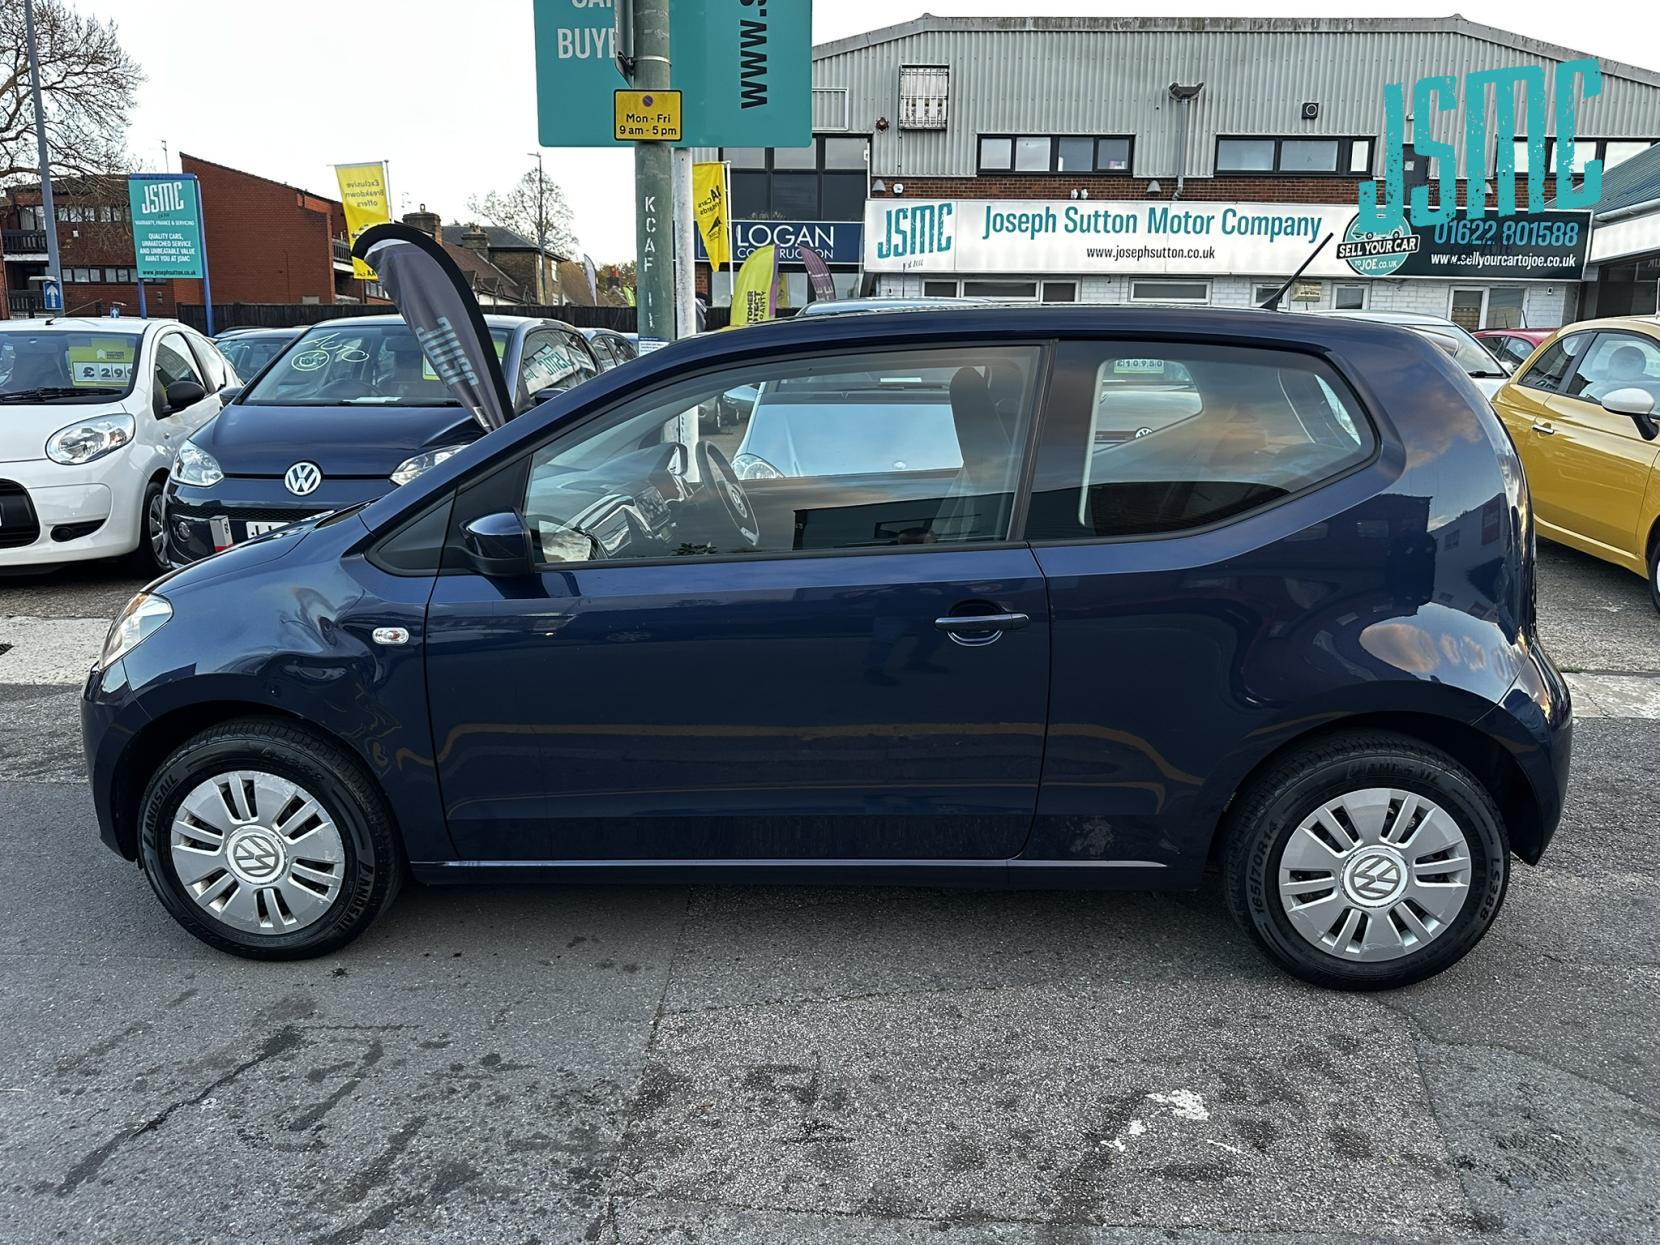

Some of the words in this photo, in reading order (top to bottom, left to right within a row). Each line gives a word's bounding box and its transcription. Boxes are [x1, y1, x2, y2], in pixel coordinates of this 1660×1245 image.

[557, 28, 615, 59] BUYE
[740, 0, 767, 109] www.
[626, 113, 648, 123] Mon
[657, 113, 671, 123] Fri
[141, 182, 184, 214] JSMC
[737, 225, 834, 247] LOGAN
[877, 202, 953, 259] JSMC
[982, 206, 1057, 240] Joseph
[1064, 206, 1138, 234] Sutton
[1147, 207, 1215, 234] Motor
[1221, 208, 1322, 243] Company
[1434, 220, 1497, 245] 01622
[1502, 221, 1579, 246] 801588
[1087, 245, 1215, 261] www.josephsutton.co.uk
[1339, 243, 1363, 257] SELL
[1365, 240, 1393, 254] YOUR
[1394, 238, 1416, 251] CAR
[1431, 251, 1576, 270] www.sellyourcartojoe.co.uk
[415, 316, 479, 386] JSMC
